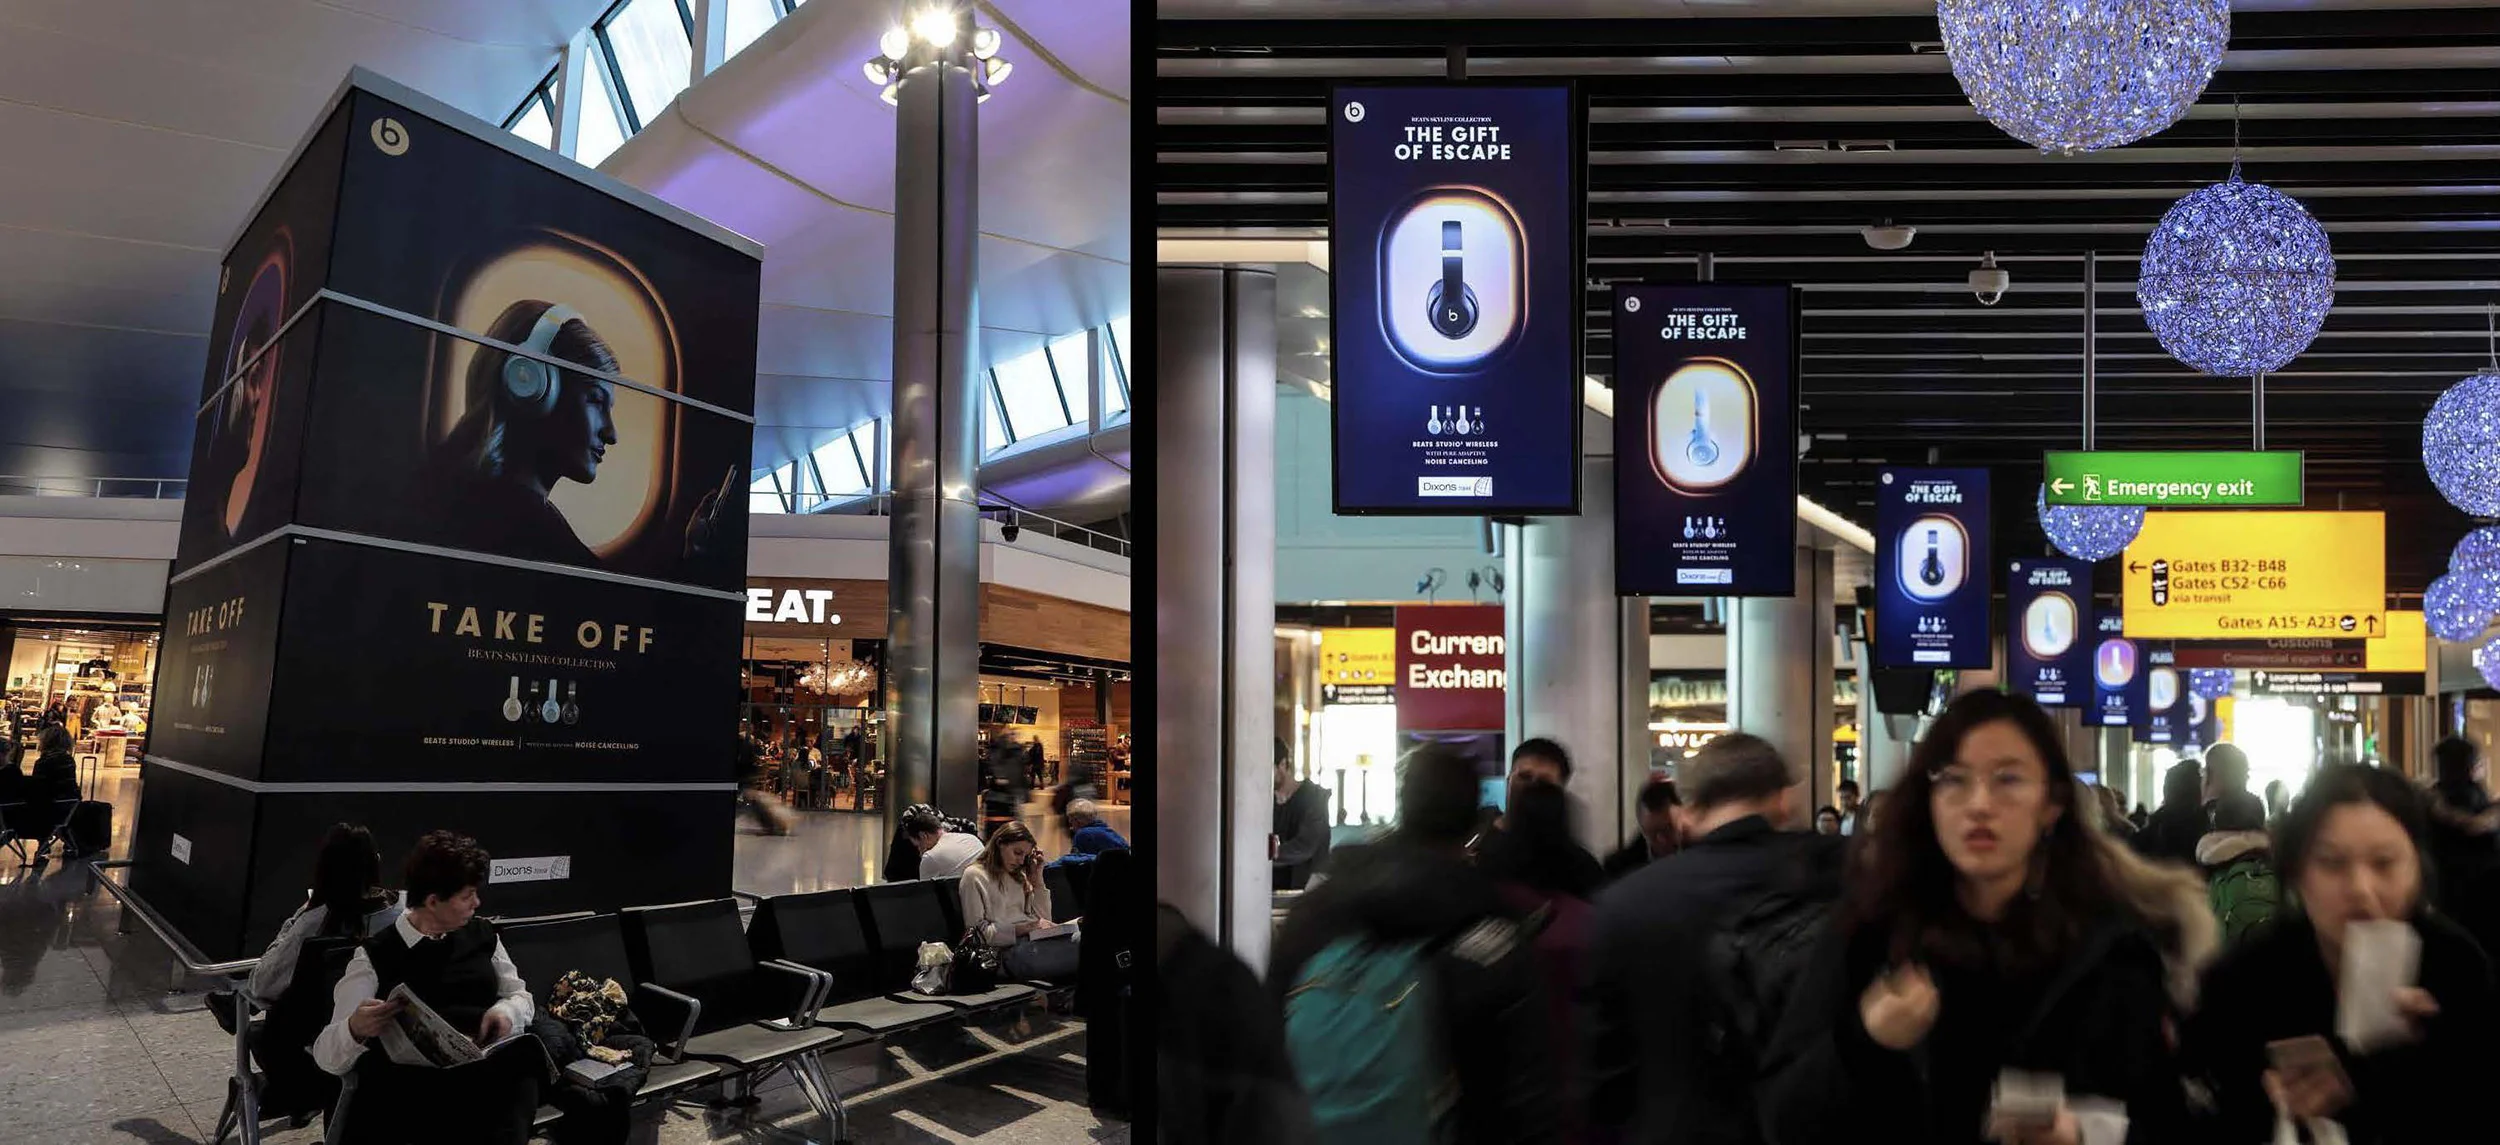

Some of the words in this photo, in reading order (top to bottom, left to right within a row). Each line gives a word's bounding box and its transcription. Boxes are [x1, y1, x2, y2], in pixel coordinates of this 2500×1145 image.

[1404, 126, 1442, 142] THE
[1451, 126, 1500, 142] GIFT
[1394, 144, 1423, 160] OF
[1432, 144, 1511, 160] ESCAPE
[1667, 314, 1696, 326] THE
[1702, 314, 1738, 326] GIFT
[1661, 327, 1682, 340] OF
[1687, 327, 1746, 340] ESCAPE
[1423, 482, 1457, 491] Dixons
[1910, 484, 1930, 494] THE
[2107, 479, 2212, 499] Emergency
[2216, 479, 2254, 496] exit
[1904, 493, 1920, 502] OF
[1922, 493, 1962, 502] ESCAPE
[2172, 560, 2216, 572] Gates
[2221, 560, 2286, 572] B32-B48
[2172, 576, 2216, 590] Gates
[2221, 576, 2286, 590] C52-C66
[2173, 594, 2190, 603] via
[2194, 593, 2232, 603] transit
[746, 588, 841, 625] EAT.
[187, 606, 214, 637] TAKE
[219, 597, 245, 630] OFF
[2218, 616, 2262, 629] Gates
[2268, 616, 2336, 629] A15-A23
[427, 602, 544, 643] TAKE
[577, 620, 654, 654] OFF
[2267, 638, 2333, 649] Customs
[468, 648, 503, 660] BEATS
[505, 651, 550, 664] SKYLINE
[551, 656, 617, 670] COLLECTION
[423, 737, 447, 745] BEATS
[575, 741, 596, 749] NOISE
[598, 742, 640, 750] CANCELLING
[494, 866, 533, 877] Dixons
